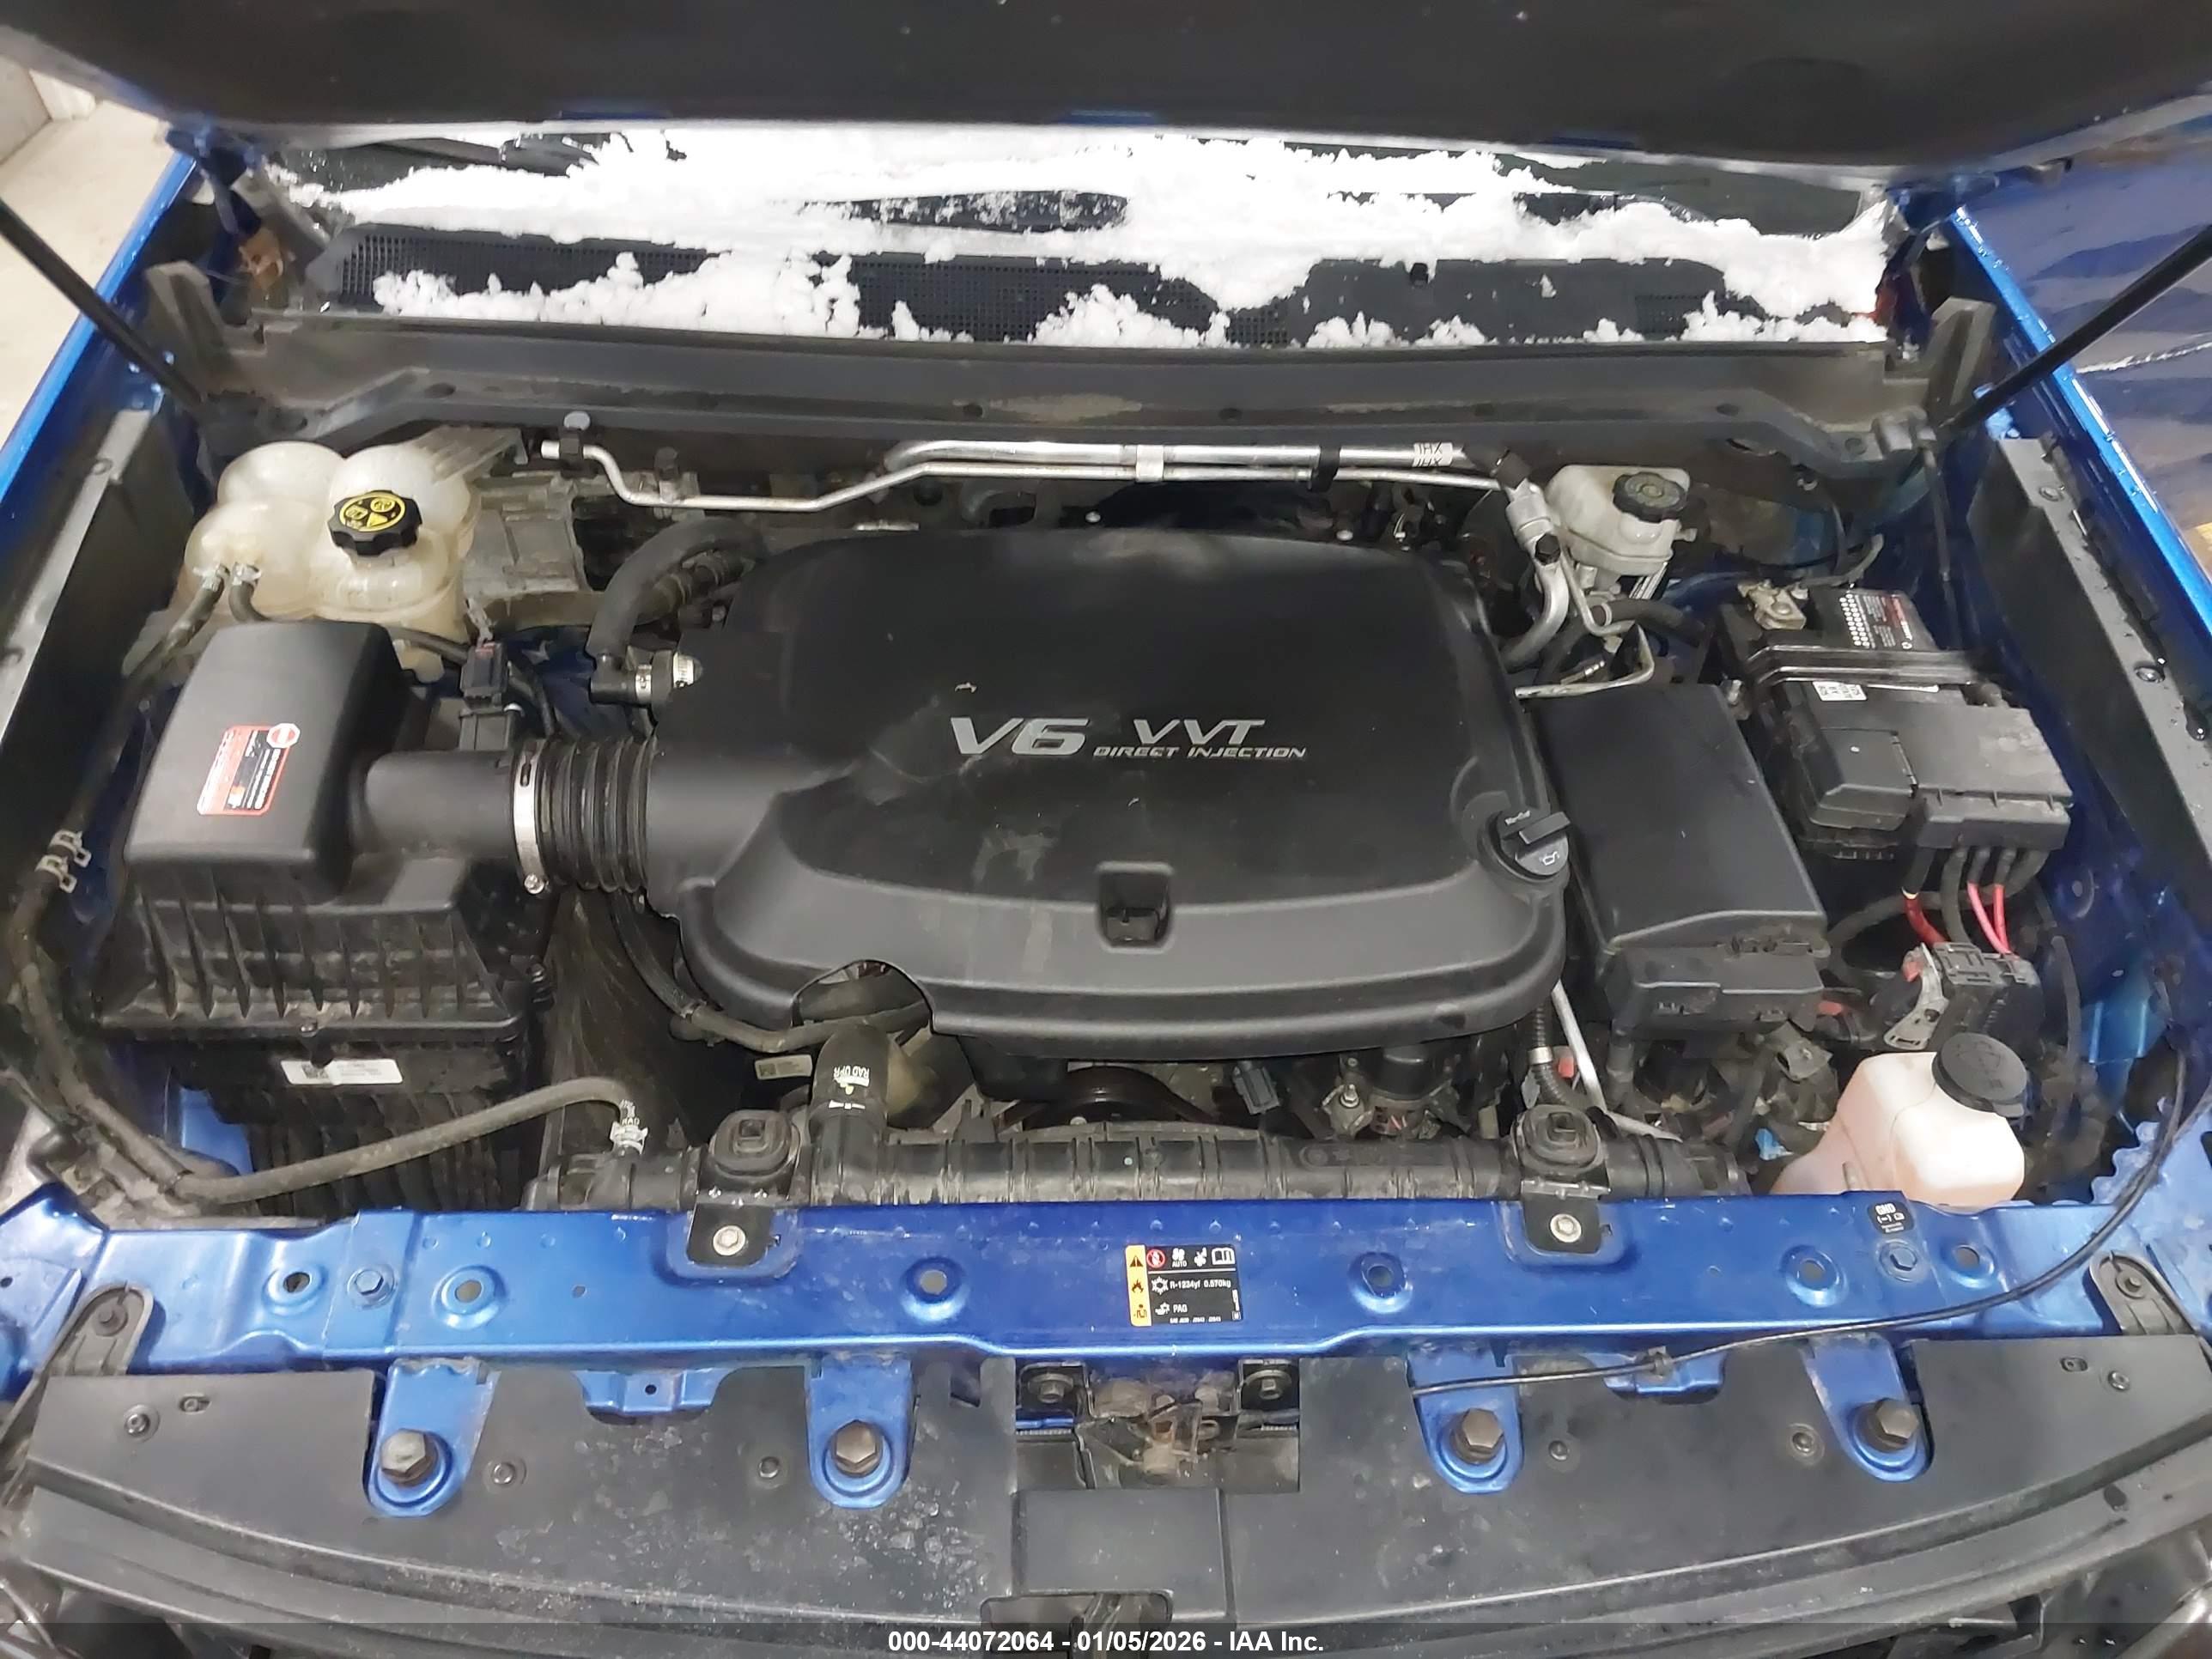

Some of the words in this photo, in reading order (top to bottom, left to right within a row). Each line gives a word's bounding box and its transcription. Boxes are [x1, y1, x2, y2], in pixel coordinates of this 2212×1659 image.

[951, 717, 1090, 756] V6
[1133, 720, 1266, 744] VVT
[1093, 746, 1180, 757] DIRECT
[1188, 747, 1307, 758] INJECTION
